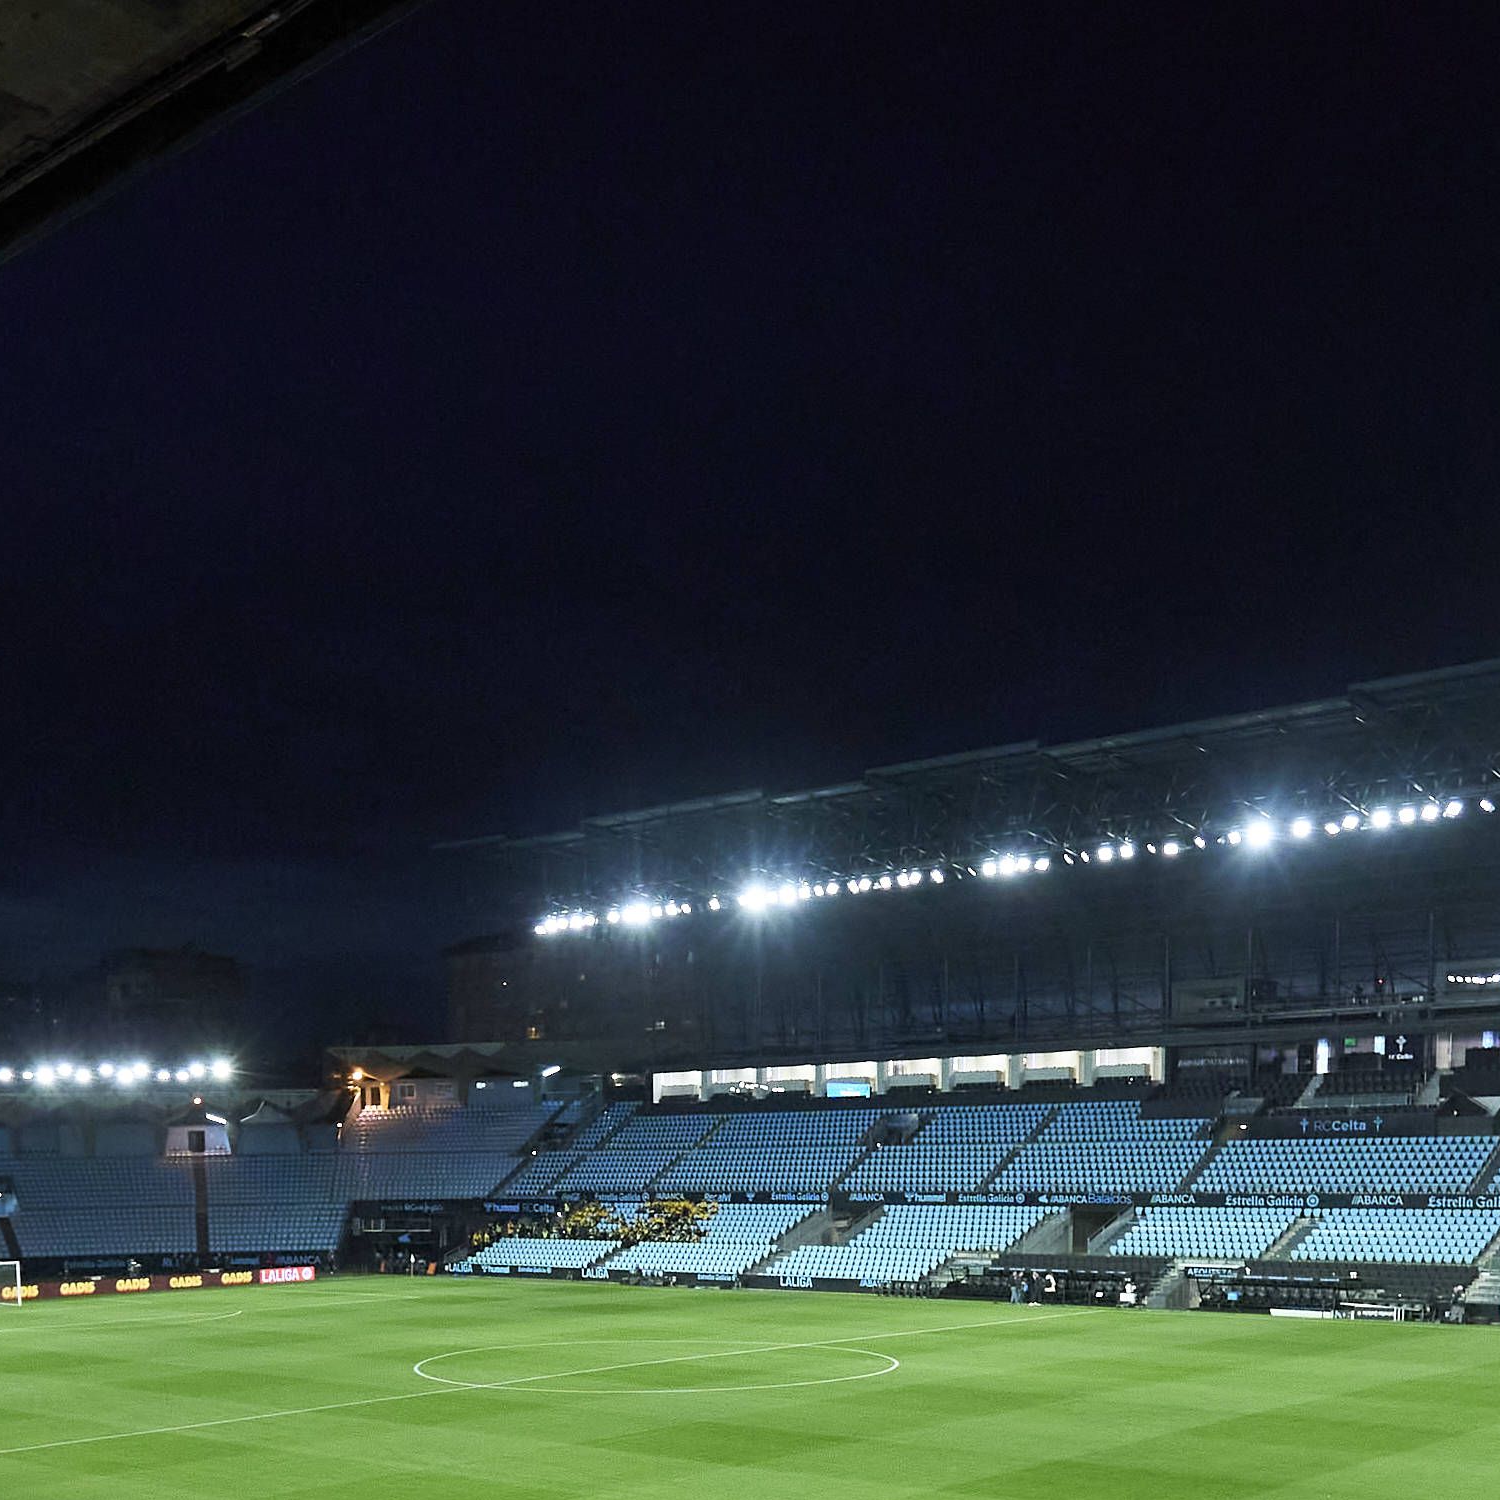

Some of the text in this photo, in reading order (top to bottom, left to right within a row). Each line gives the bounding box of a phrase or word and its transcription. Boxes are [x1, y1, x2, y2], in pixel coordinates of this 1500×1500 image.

[771, 1192, 820, 1202] Estrella Galicia
[853, 1193, 884, 1202] ABANCA
[958, 1193, 1014, 1203] Estrella Galicia
[1054, 1194, 1088, 1204] ABANCA
[1155, 1194, 1195, 1204] ABANCA
[1225, 1193, 1304, 1207] Estrella Galicia
[1358, 1196, 1404, 1206] ABANCA
[1428, 1196, 1473, 1208] Estrella
[221, 1271, 253, 1285] GADIS
[261, 1269, 300, 1283] LALIGA
[581, 1268, 609, 1279] LALIGA
[60, 1280, 96, 1295] GADIS
[115, 1277, 150, 1292] GADIS
[169, 1274, 203, 1289] GADIS
[780, 1276, 813, 1288] LALIGA
